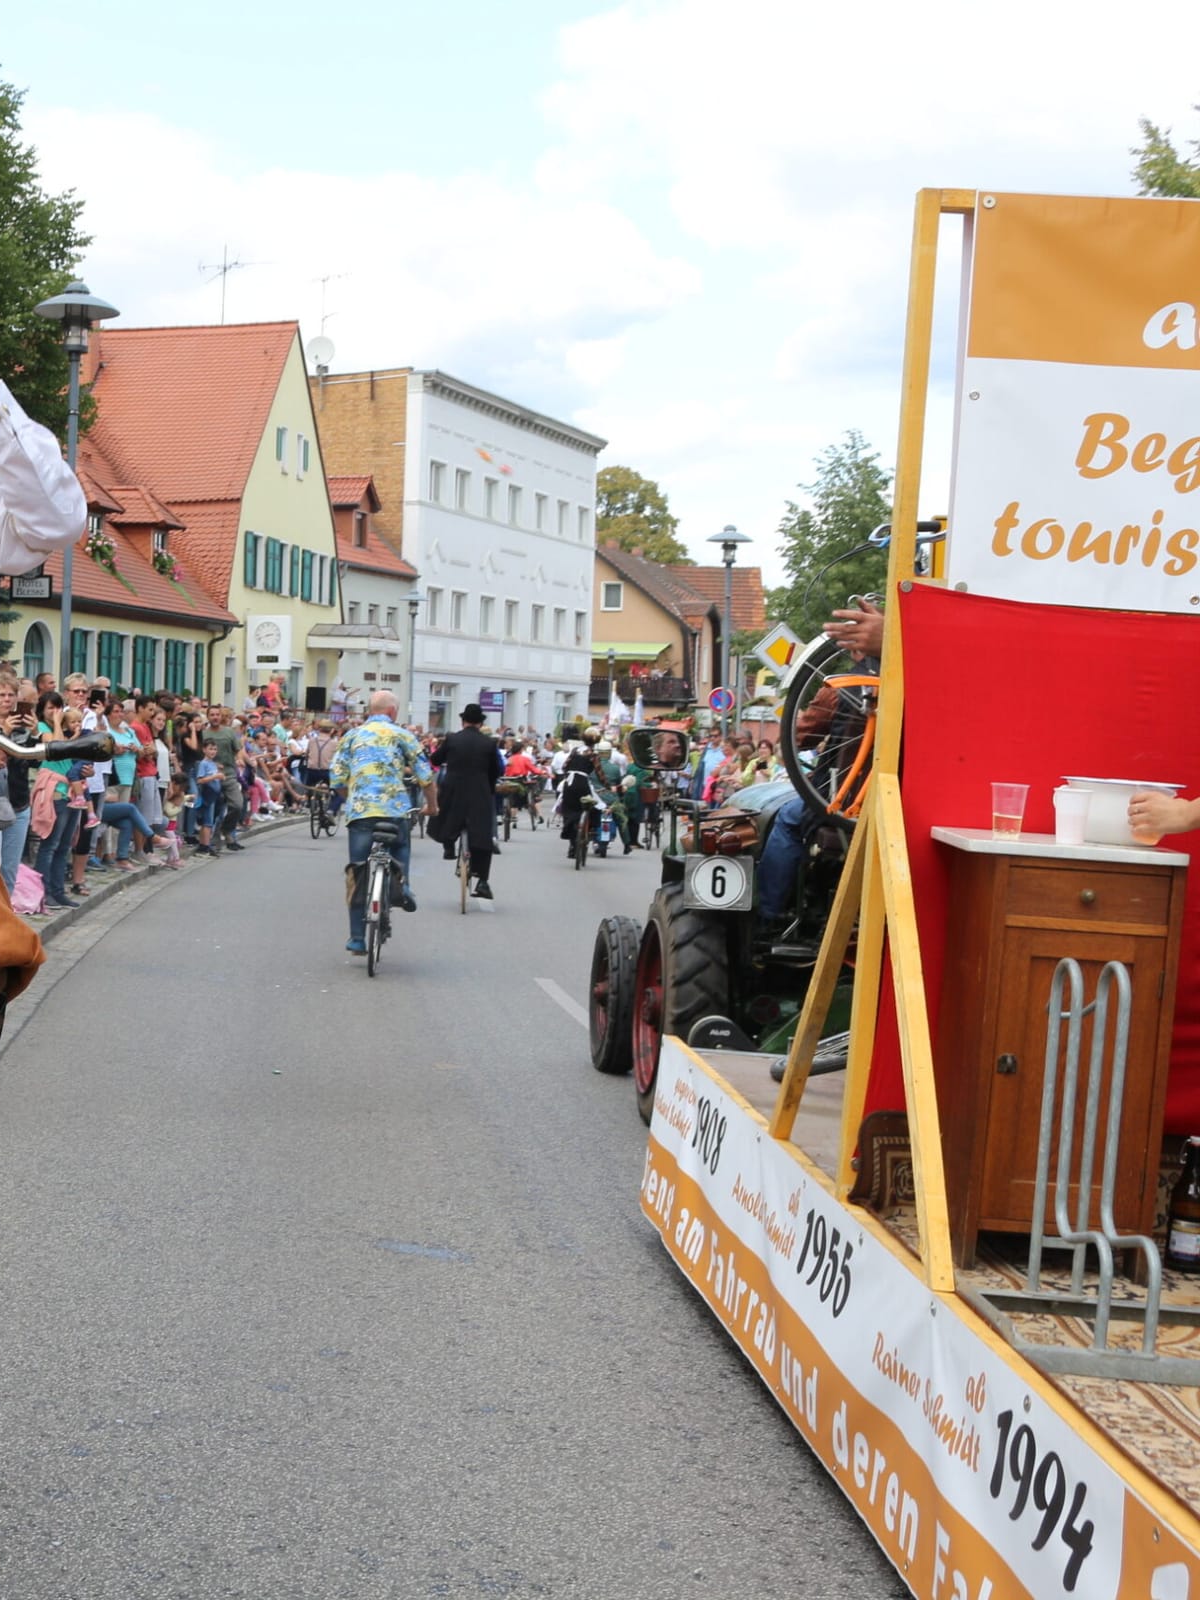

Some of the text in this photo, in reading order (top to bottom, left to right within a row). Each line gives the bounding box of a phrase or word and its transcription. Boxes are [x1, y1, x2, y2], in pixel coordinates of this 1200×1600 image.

[1142, 301, 1200, 350] a
[711, 865, 727, 899] 6
[691, 1095, 728, 1177] 1908
[796, 1208, 854, 1319] 1955
[675, 1207, 705, 1265] am
[706, 1229, 777, 1367] Fahrrad
[780, 1341, 818, 1434] und
[832, 1400, 919, 1564] deren
[871, 1331, 981, 1473] Rainer Schmidt
[965, 1371, 987, 1414] ab
[990, 1409, 1095, 1593] 1994
